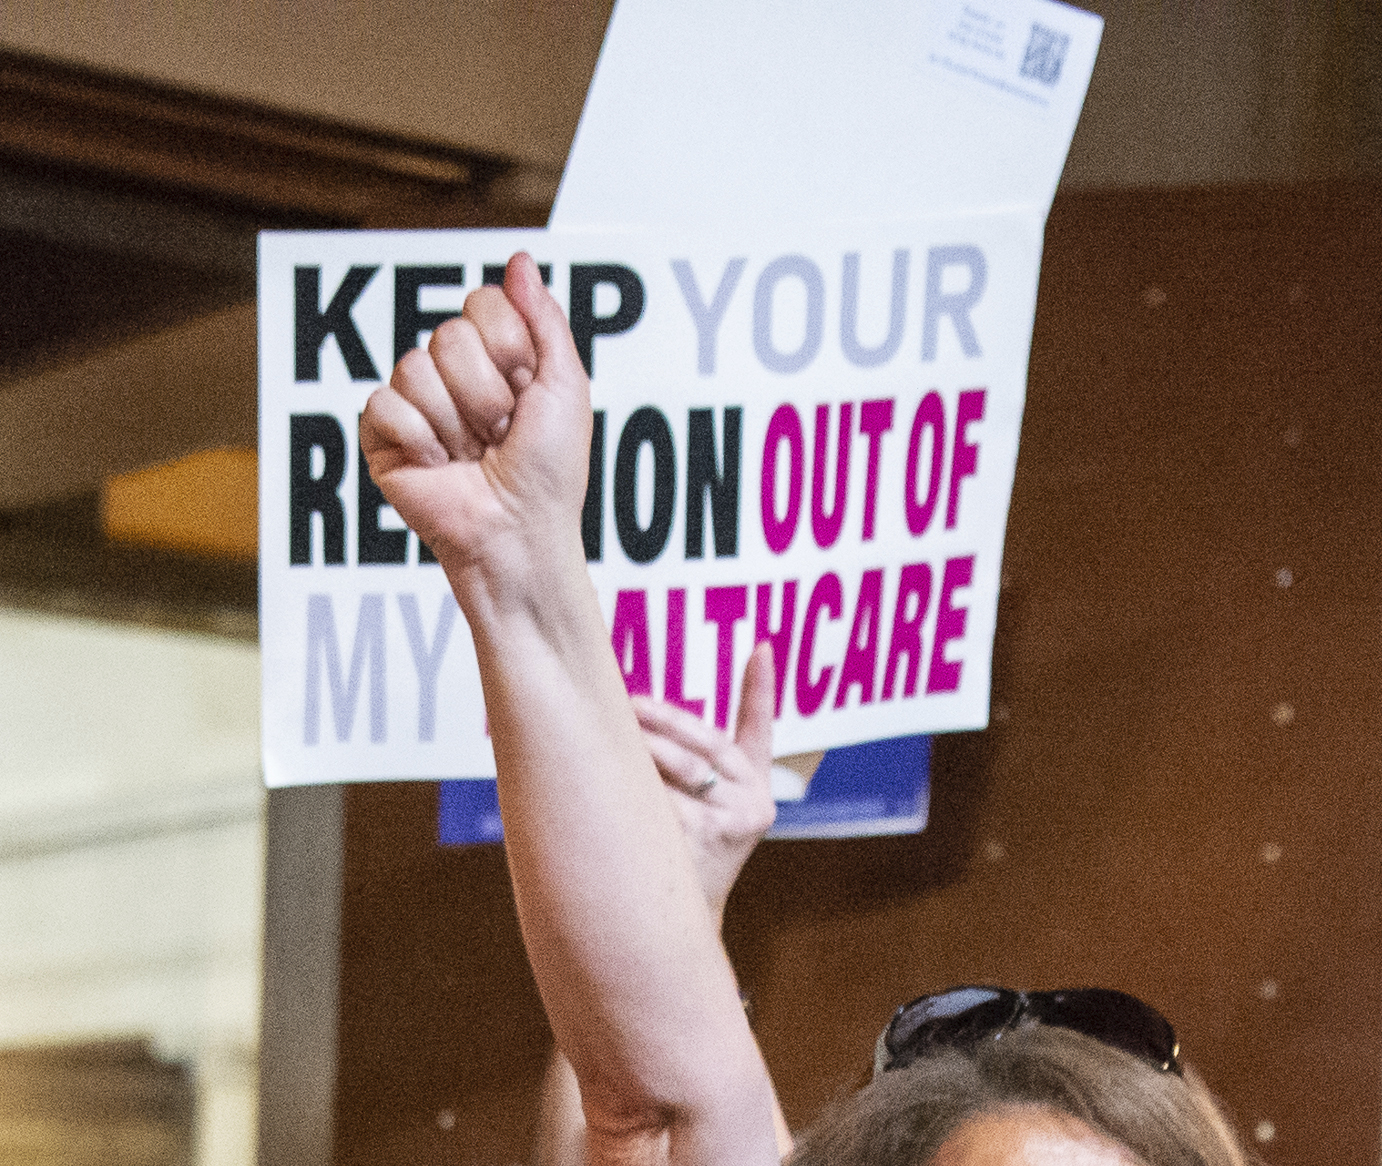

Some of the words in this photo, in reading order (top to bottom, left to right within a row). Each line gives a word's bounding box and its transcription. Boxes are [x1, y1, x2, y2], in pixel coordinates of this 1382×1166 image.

[293, 263, 647, 382] KEP
[668, 243, 988, 377] YOUR
[289, 404, 744, 567] REION
[760, 398, 896, 556] OUT
[905, 387, 987, 538] OF
[303, 593, 458, 746] MY
[485, 553, 976, 737] ALTHCARE
